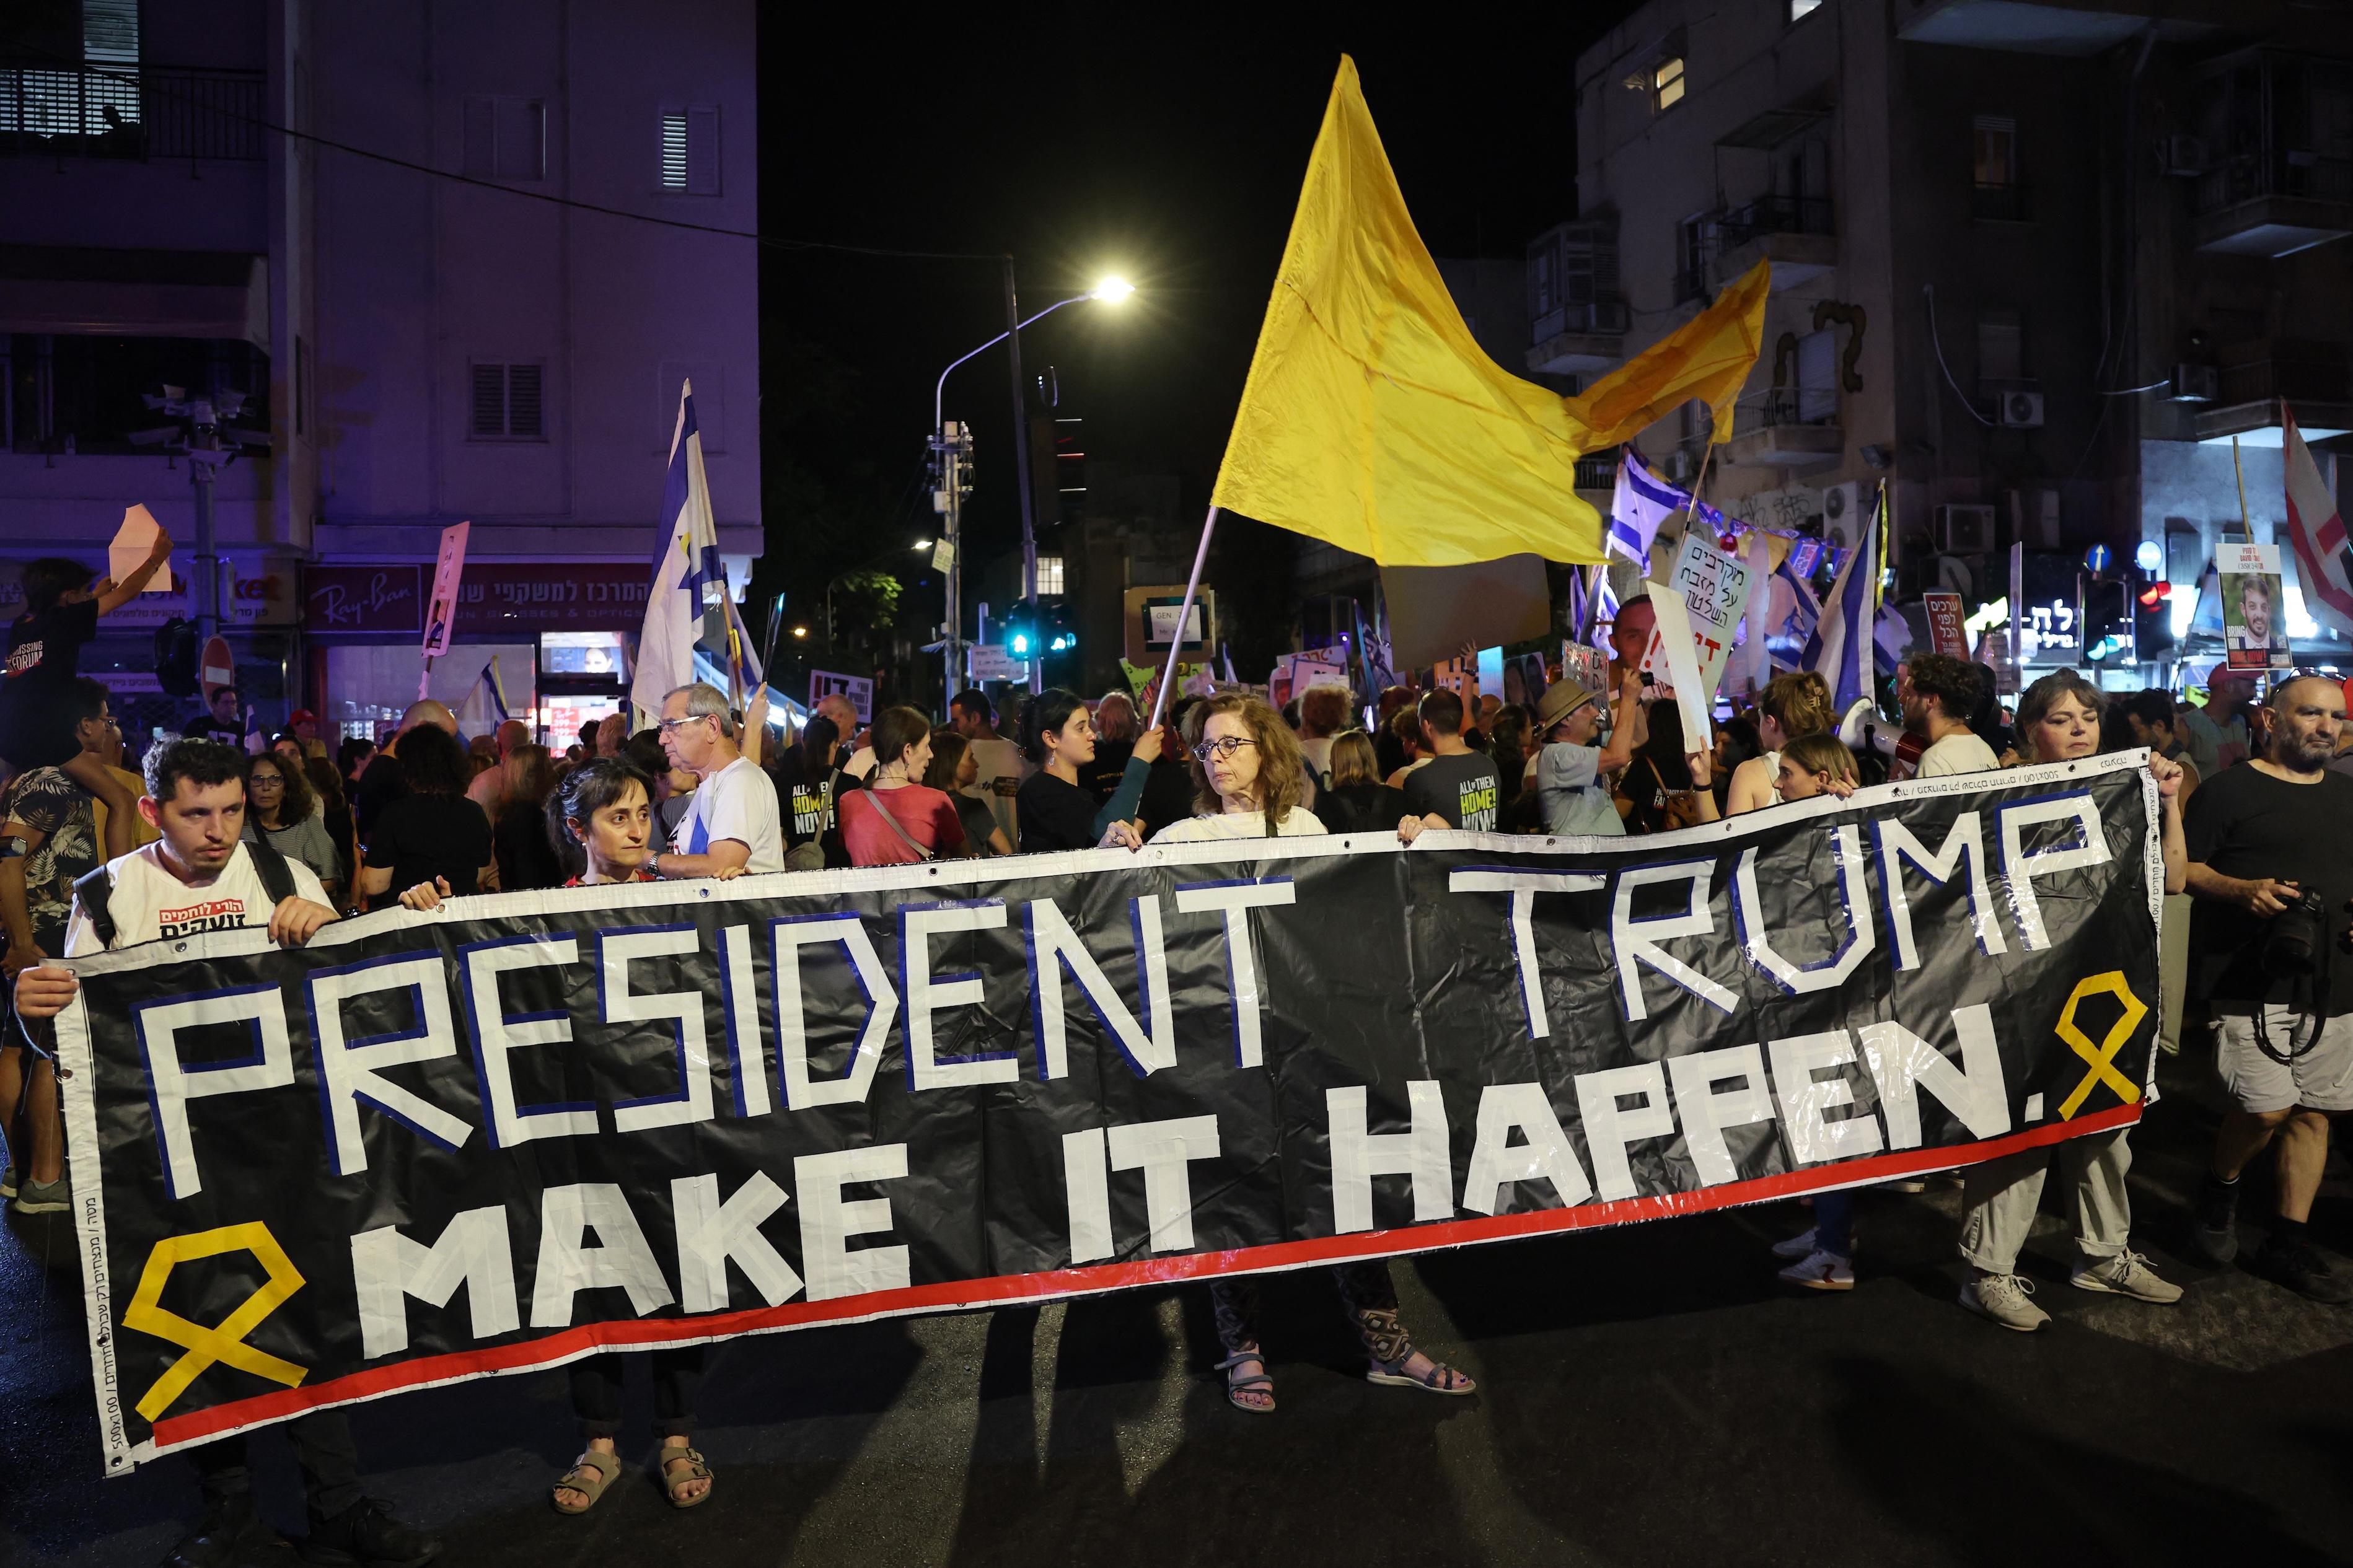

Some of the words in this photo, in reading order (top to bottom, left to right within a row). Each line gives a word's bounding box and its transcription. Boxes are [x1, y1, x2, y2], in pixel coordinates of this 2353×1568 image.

[496, 579, 579, 605] למשקפי
[586, 582, 650, 602] המרכז
[1681, 567, 1715, 596] מזבח
[309, 572, 413, 624] Ray-Ban
[1686, 590, 1728, 626] השלטון
[1722, 587, 1738, 608] על
[1930, 600, 1958, 612] ערכים
[454, 609, 475, 619] UN
[587, 610, 644, 618] OPTICS
[1938, 611, 1956, 625] לפני
[1939, 625, 1958, 638] הכל
[2227, 626, 2245, 637] BRING
[2228, 637, 2240, 650] HIM
[2100, 757, 2127, 769] למעלה
[793, 784, 807, 797] ALL
[1460, 780, 1474, 796] ALL
[1474, 774, 1496, 791] THEM
[1917, 784, 1947, 795] מנצחים
[1950, 782, 1961, 793] רק
[1990, 776, 2017, 787] חוזרים
[2023, 771, 2060, 783] 500x100
[1460, 787, 1497, 815] HOME!
[1462, 807, 1497, 831] NOW!
[161, 902, 212, 922] לוחמים
[216, 901, 244, 912] הורי
[131, 875, 1296, 1199] PRESIDENT
[1449, 788, 2113, 1039] TRUMP
[350, 1142, 910, 1360] MAKE
[1062, 1114, 1221, 1264] IT
[1326, 1002, 2044, 1235] HAPPEN.
[86, 1197, 97, 1225] מטה
[89, 1237, 103, 1282] מנצחים
[96, 1284, 110, 1302] רק
[102, 1343, 117, 1386] חוזרים
[107, 1396, 124, 1450] 500x100
